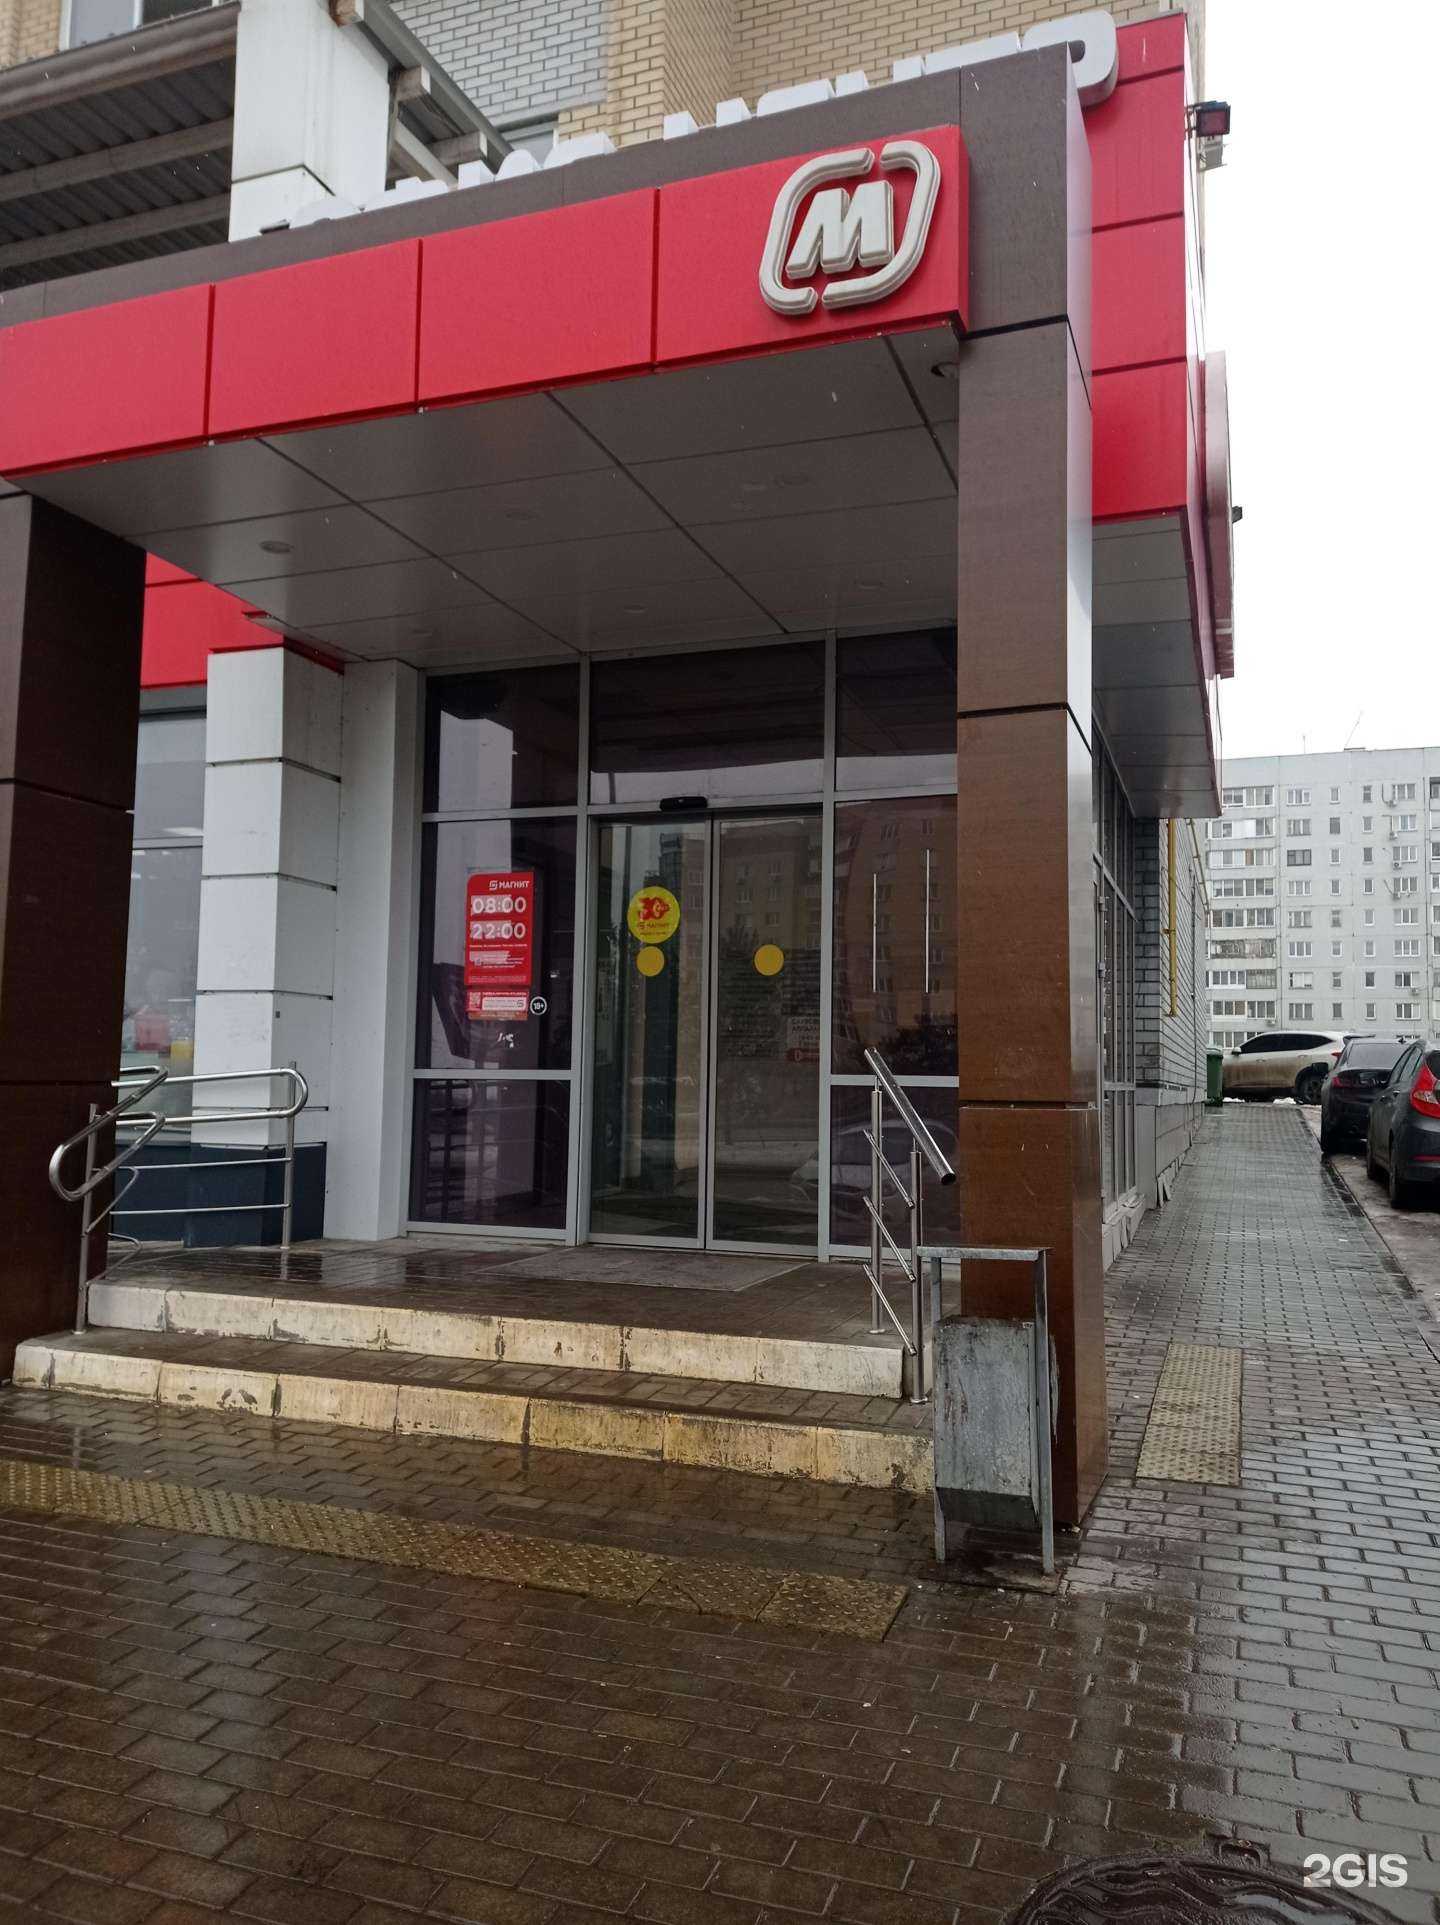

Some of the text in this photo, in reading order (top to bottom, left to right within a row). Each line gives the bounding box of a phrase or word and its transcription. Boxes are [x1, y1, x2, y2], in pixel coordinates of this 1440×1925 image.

[498, 881, 530, 889] МАГНИТ
[472, 896, 527, 914] 08:00
[471, 922, 526, 939] 22:00
